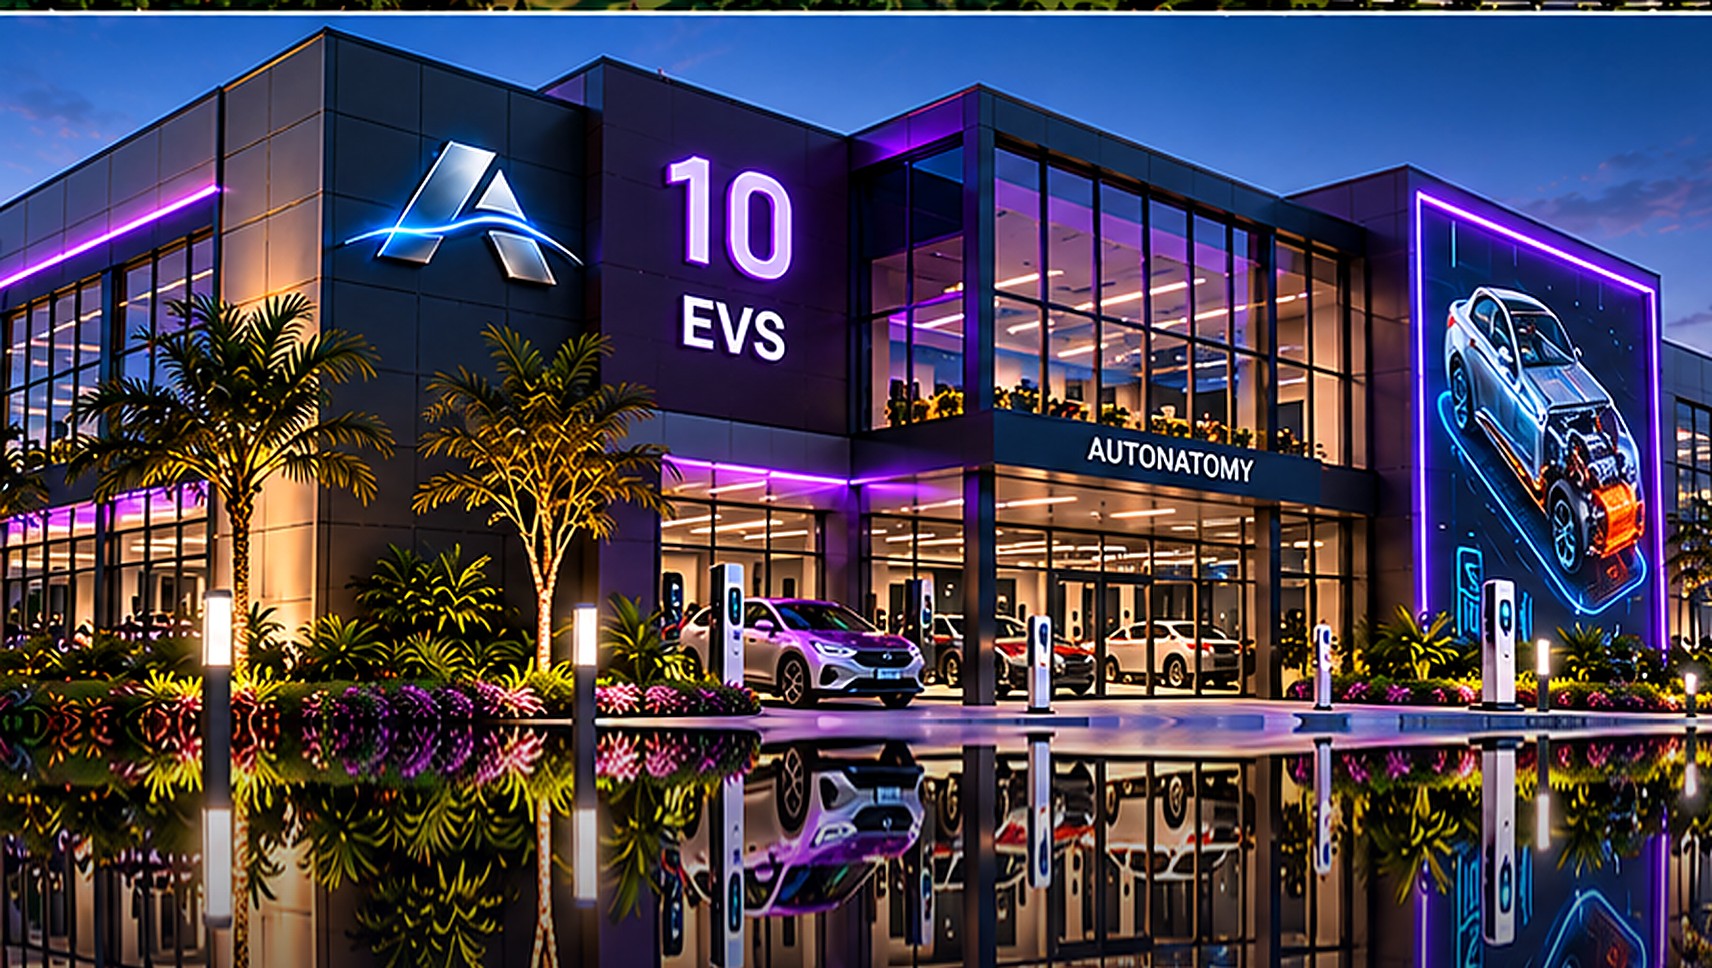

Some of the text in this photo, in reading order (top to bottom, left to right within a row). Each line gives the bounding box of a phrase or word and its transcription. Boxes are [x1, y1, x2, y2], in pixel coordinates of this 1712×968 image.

[666, 155, 793, 281] 10
[682, 294, 786, 363] EVS
[1087, 436, 1254, 483] AUTONATOMY
